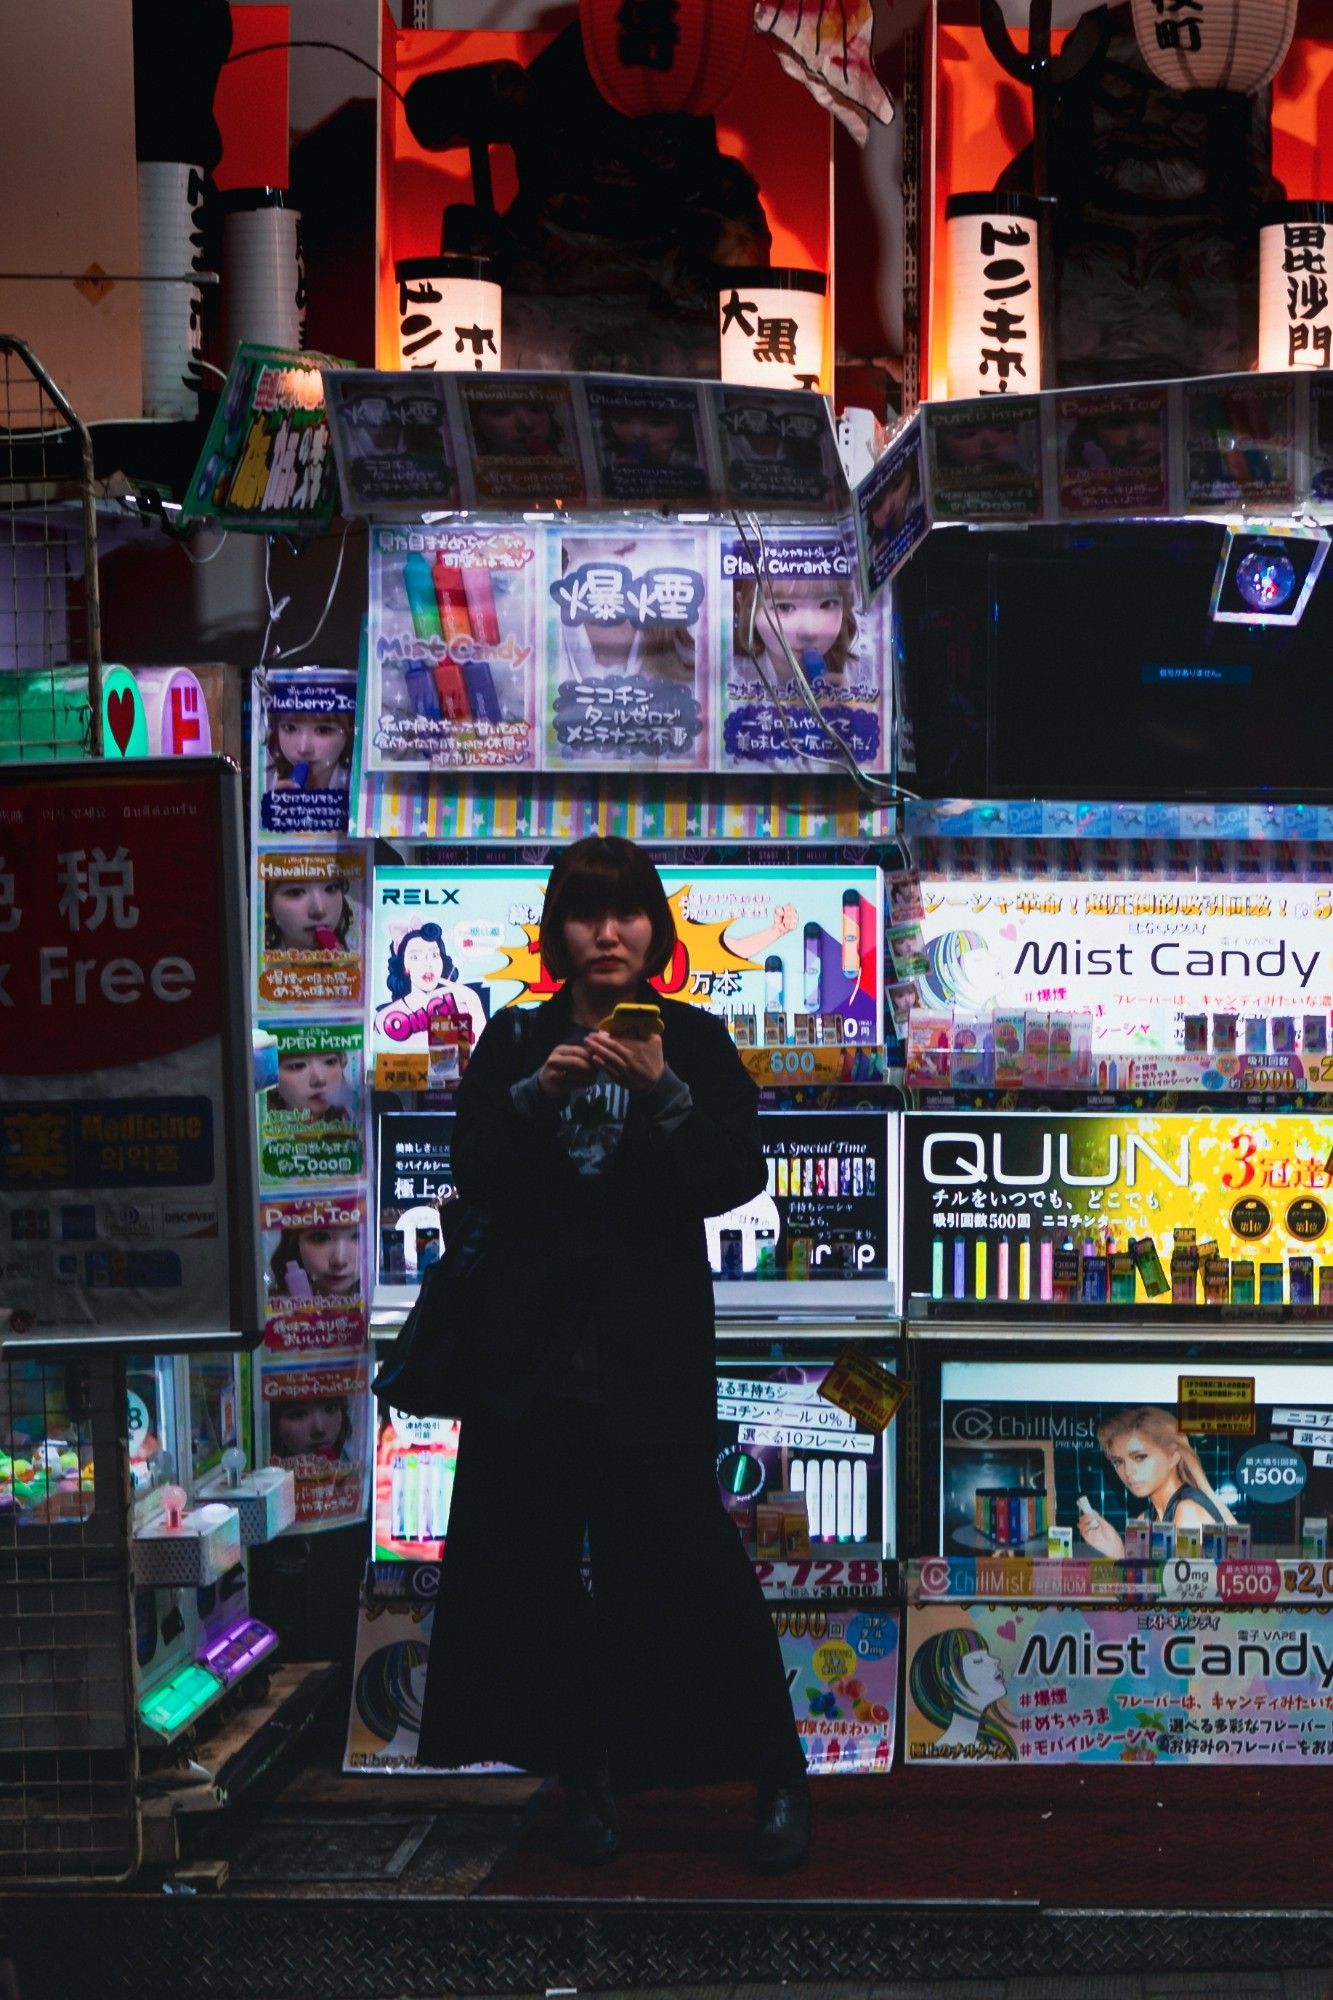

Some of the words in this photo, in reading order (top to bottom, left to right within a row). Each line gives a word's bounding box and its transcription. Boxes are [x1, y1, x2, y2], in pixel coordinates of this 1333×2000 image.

[560, 569, 694, 623] 爆煙
[376, 633, 448, 662] Mist
[449, 633, 532, 669] Candy
[575, 686, 653, 706] ニコチン
[585, 705, 680, 725] タールゼロで
[261, 863, 326, 878] Hawaiian
[382, 888, 460, 905] RELX
[1013, 939, 1133, 976] Mist
[1150, 939, 1321, 988] Candy
[38, 946, 196, 1006] Free
[689, 969, 743, 995] 万本
[275, 1036, 318, 1050] UPER
[321, 1034, 362, 1048] MINT
[769, 1051, 816, 1074] 600
[1242, 1070, 1297, 1091] 5000
[80, 1113, 203, 1142] Medicine
[789, 1141, 835, 1157] Special
[837, 1142, 867, 1155] Time
[922, 1132, 1191, 1186] QUUN
[265, 1208, 325, 1229] Peach
[325, 1207, 361, 1224] Ice
[998, 1415, 1095, 1438] ChillMist
[1055, 1439, 1095, 1450] PREMIUM
[1240, 1466, 1296, 1486] 1,500
[954, 1570, 1025, 1594] ChillMist
[1221, 1575, 1273, 1598] 1,500
[1263, 1630, 1297, 1642] VAPE
[1016, 1632, 1147, 1677] Mist
[1163, 1632, 1333, 1690] Candy
